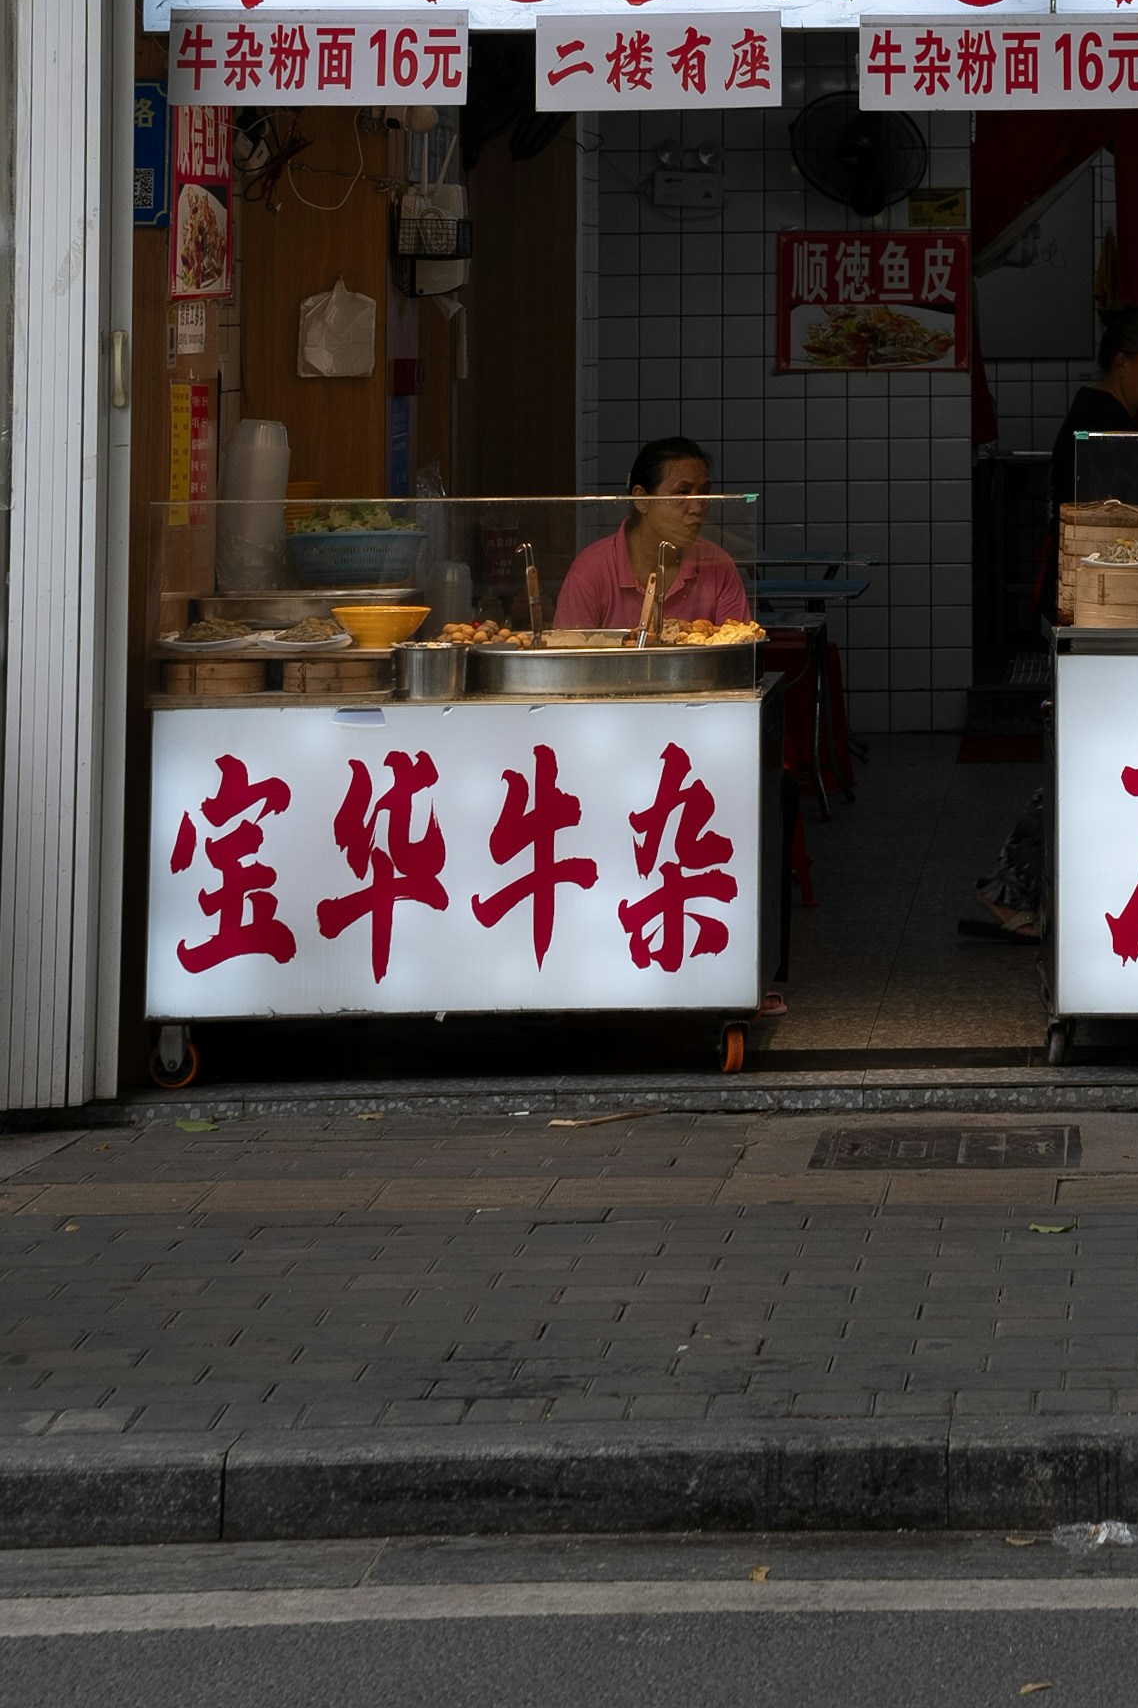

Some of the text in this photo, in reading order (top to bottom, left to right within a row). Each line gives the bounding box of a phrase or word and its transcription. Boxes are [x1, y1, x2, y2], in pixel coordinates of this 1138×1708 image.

[176, 24, 462, 91] 牛杂粉面 16元
[547, 27, 772, 94] 二楼有座
[867, 29, 1041, 96] 牛杂粉面
[170, 741, 739, 984] 宝华牛杂
